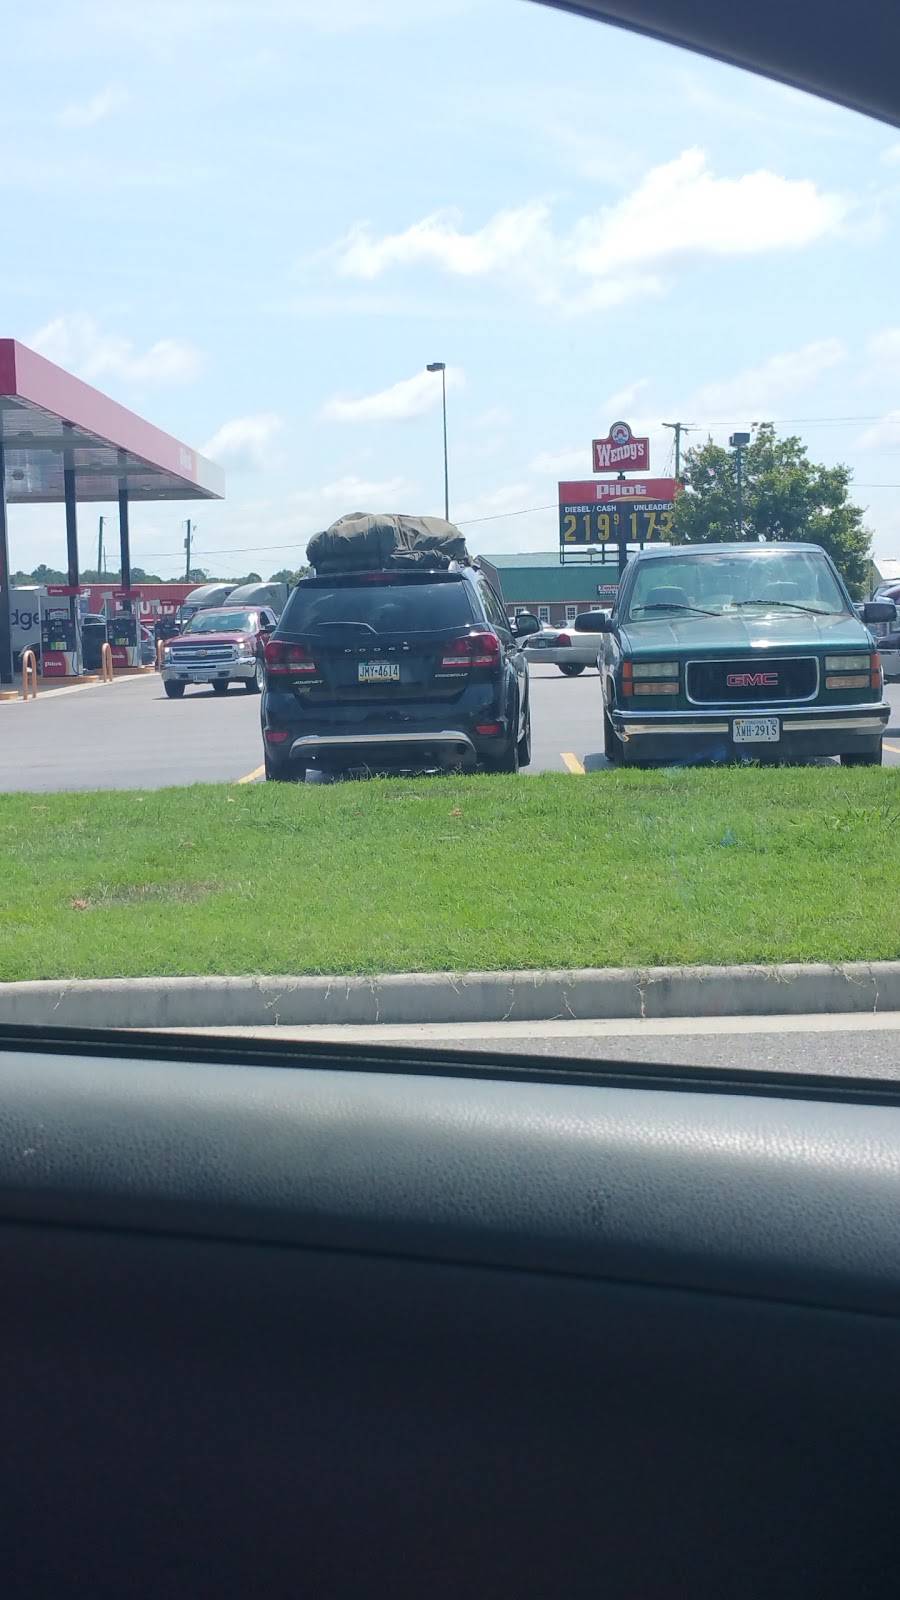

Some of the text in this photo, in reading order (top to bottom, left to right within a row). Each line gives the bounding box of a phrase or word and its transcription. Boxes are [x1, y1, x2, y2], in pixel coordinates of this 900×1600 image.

[596, 484, 647, 499] Pilot
[564, 505, 591, 513] DIESEL
[596, 504, 617, 512] CASH
[633, 503, 673, 511] UNLEADED
[727, 672, 778, 687] GMC
